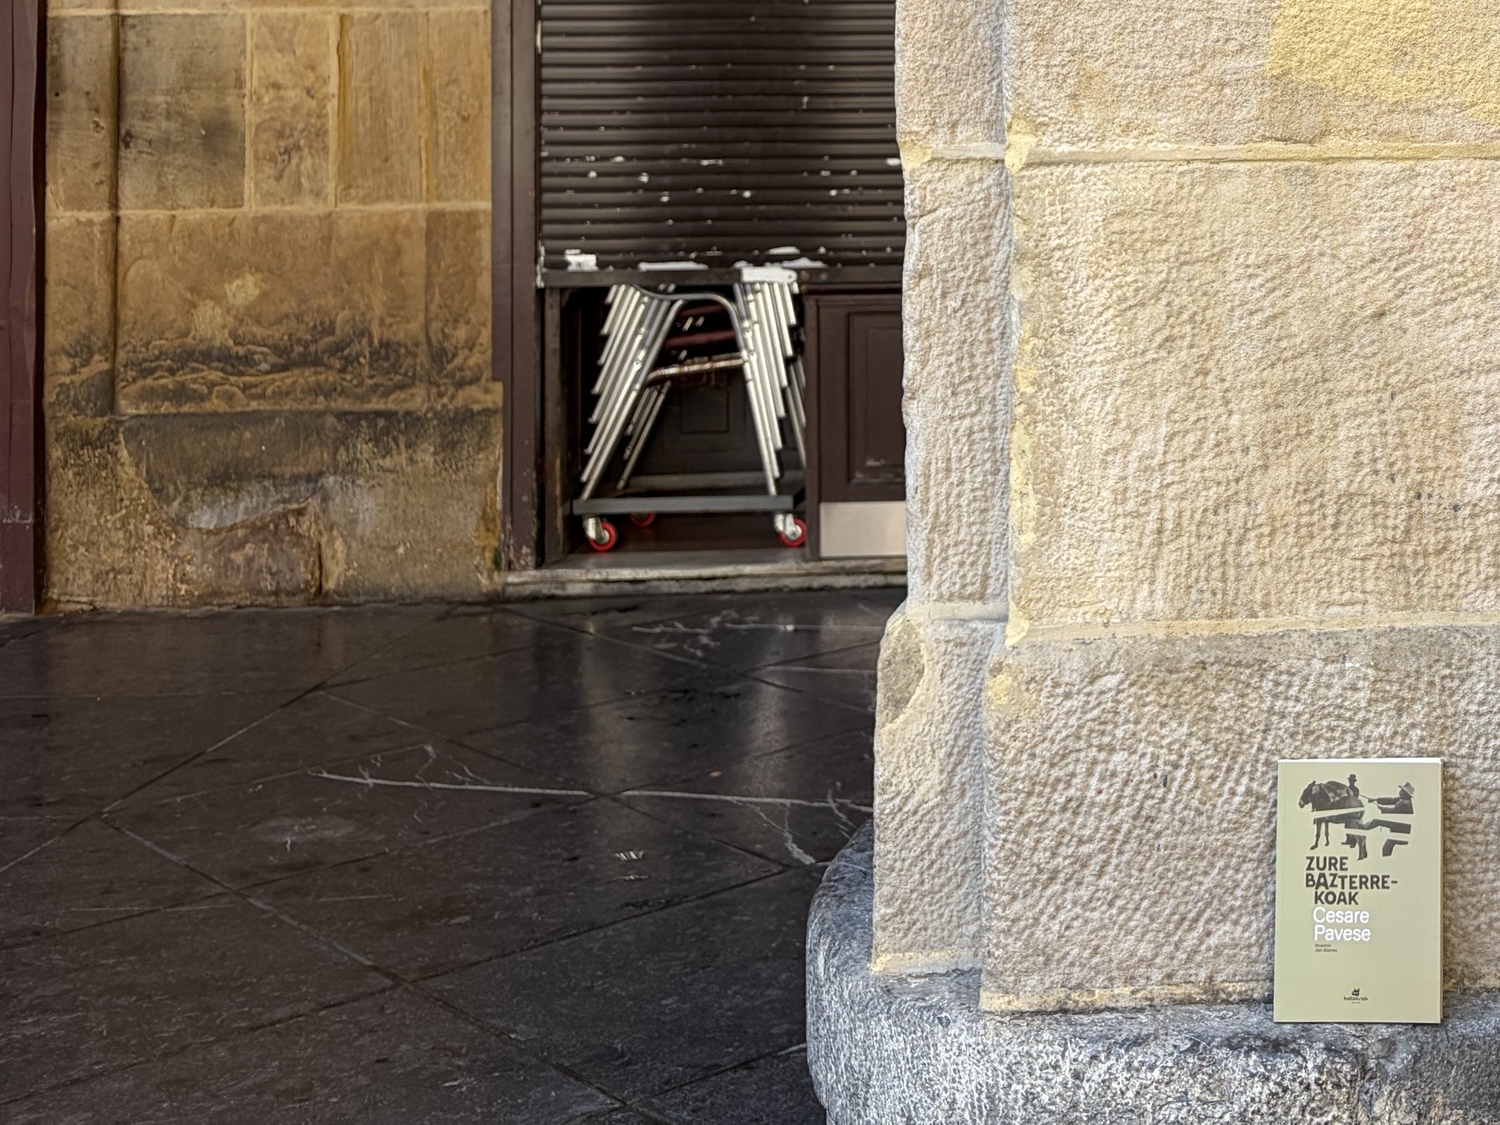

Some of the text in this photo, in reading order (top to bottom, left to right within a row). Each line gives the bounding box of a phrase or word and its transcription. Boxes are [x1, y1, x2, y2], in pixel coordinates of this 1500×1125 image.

[1305, 856, 1348, 871] ZURE
[1305, 872, 1398, 890] BAZTERRE-
[1314, 891, 1359, 905] KOAK
[1313, 906, 1370, 924] Cesare
[1314, 924, 1371, 941] Pavese
